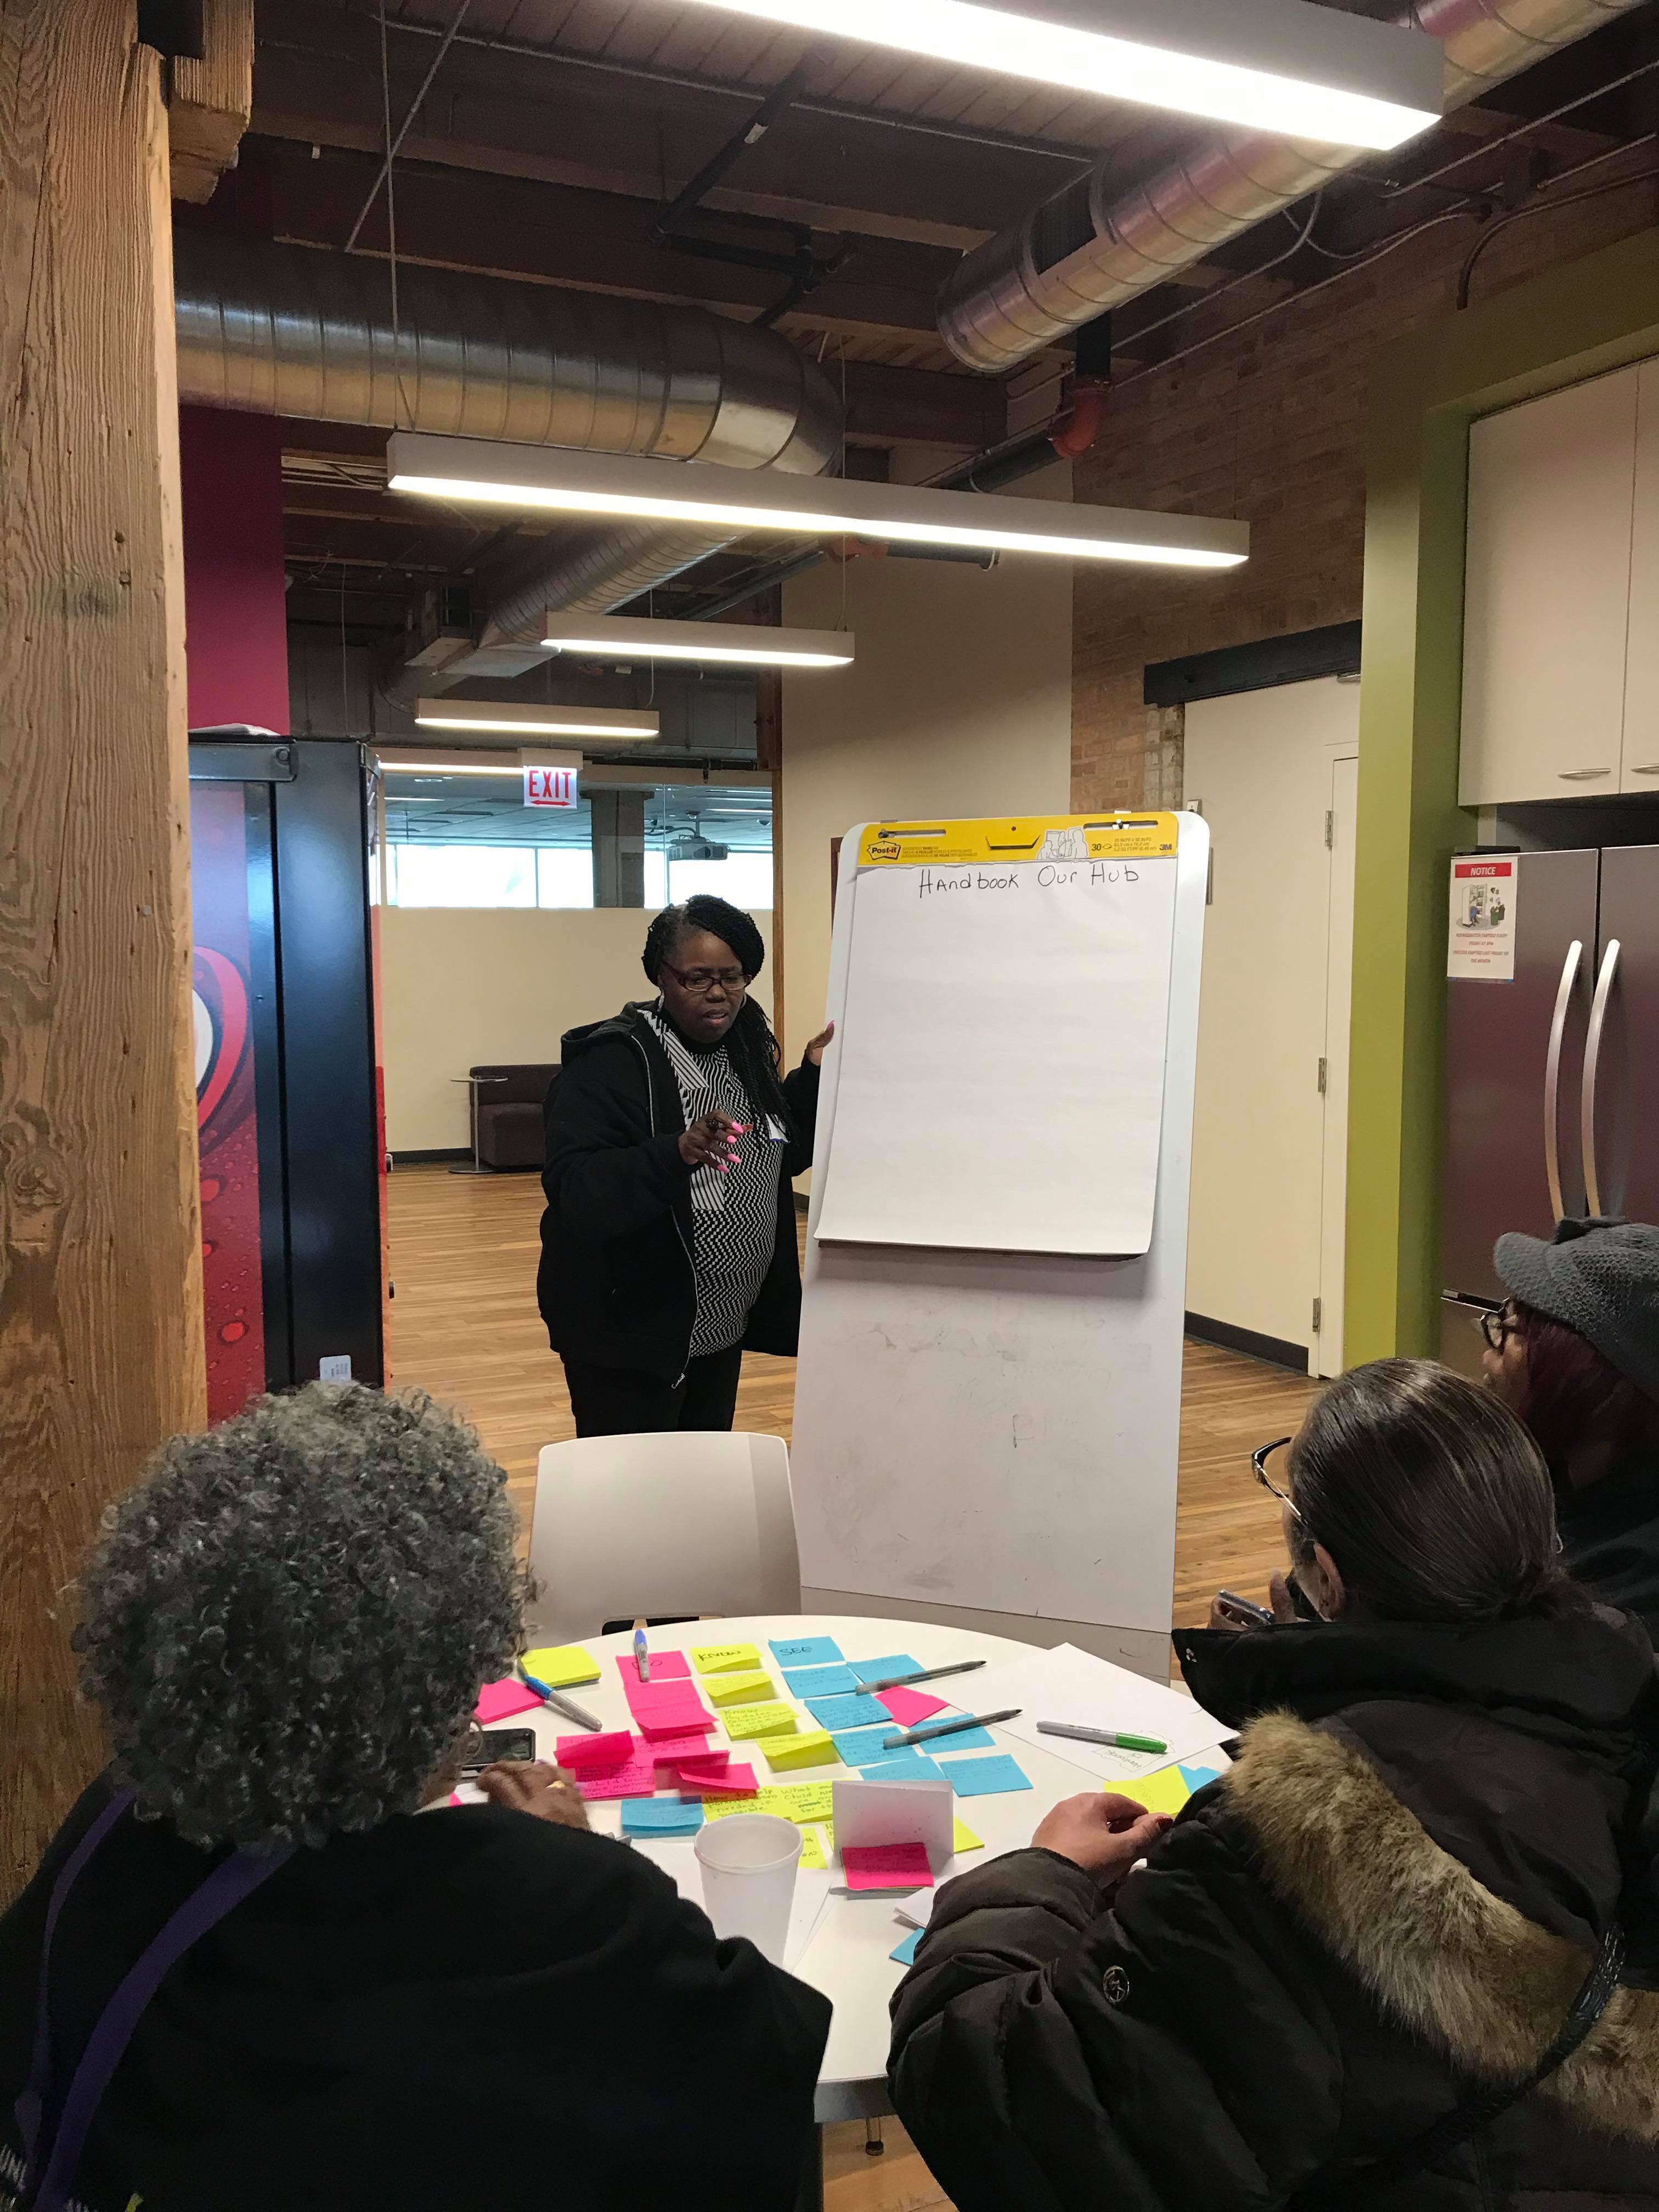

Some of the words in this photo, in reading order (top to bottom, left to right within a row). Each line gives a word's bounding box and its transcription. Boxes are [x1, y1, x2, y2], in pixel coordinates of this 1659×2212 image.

[529, 770, 572, 798] EXIT
[1091, 843, 1102, 851] 30
[1038, 865, 1077, 887] Our
[1090, 863, 1139, 886] Hub
[1470, 867, 1497, 876] NOTICE
[780, 1646, 812, 1656] SEE
